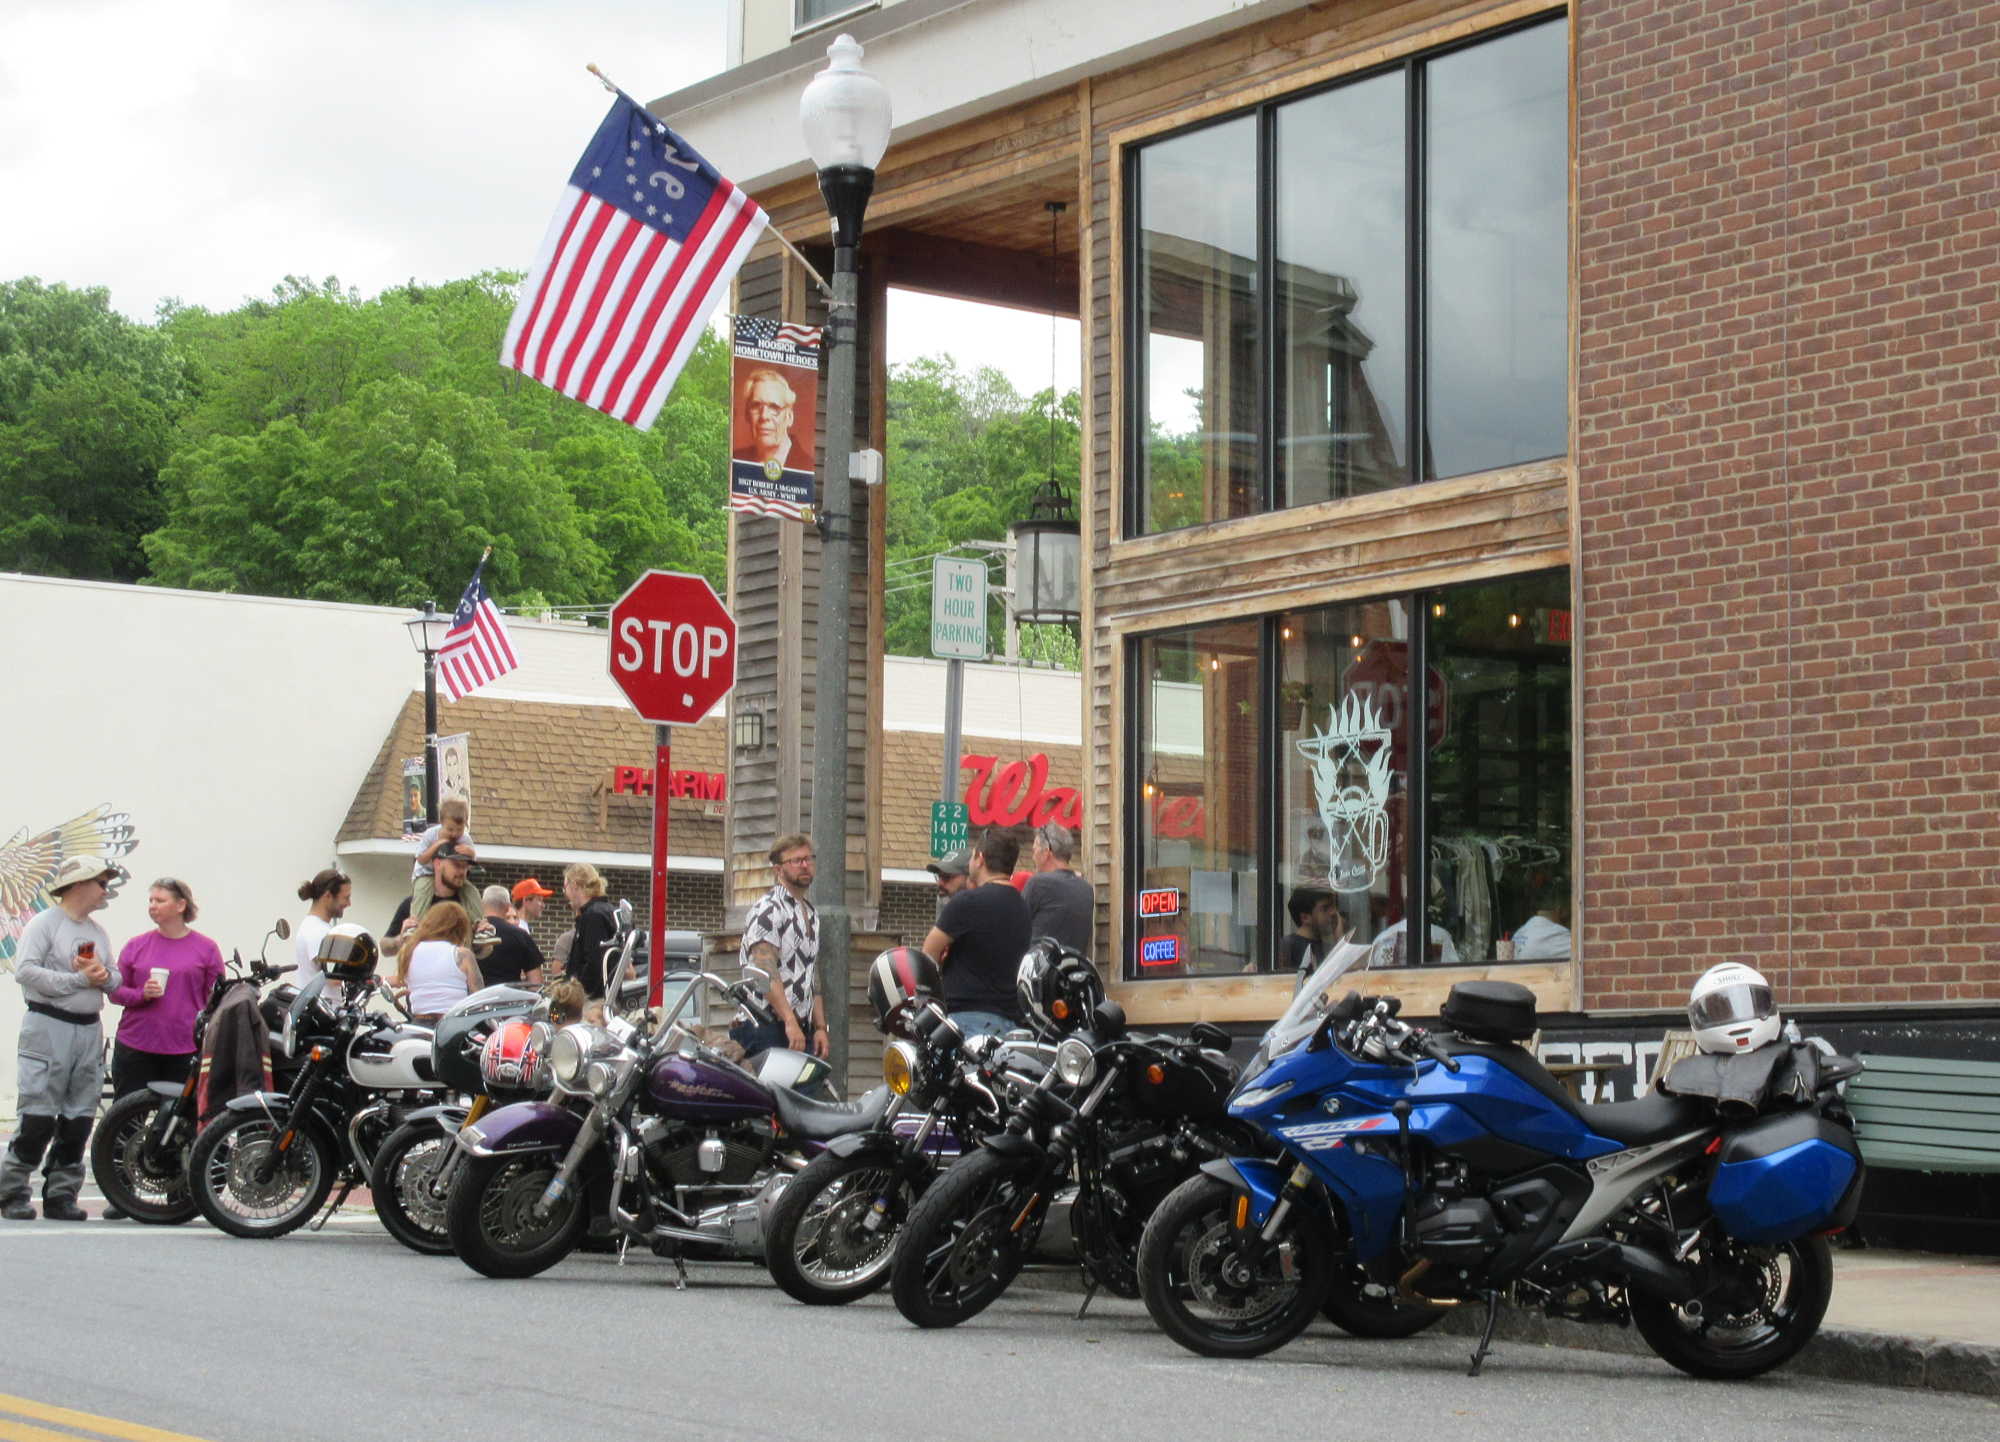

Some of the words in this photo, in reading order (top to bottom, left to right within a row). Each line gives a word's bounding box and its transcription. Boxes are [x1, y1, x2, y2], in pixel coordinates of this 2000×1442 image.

[735, 344, 784, 362] HOMETOWN
[785, 353, 818, 367] HEROES
[758, 338, 796, 354] HOOSICK
[752, 480, 774, 490] ROBERT
[759, 489, 776, 498] ARMY
[949, 573, 973, 593] TWO
[944, 598, 975, 618] HOUR
[936, 622, 983, 645] PARKING
[618, 616, 728, 679] STOP
[934, 822, 967, 836] 1407
[934, 839, 966, 852] 1300
[1142, 892, 1176, 914] OPEN
[1144, 940, 1176, 961] COFFEE
